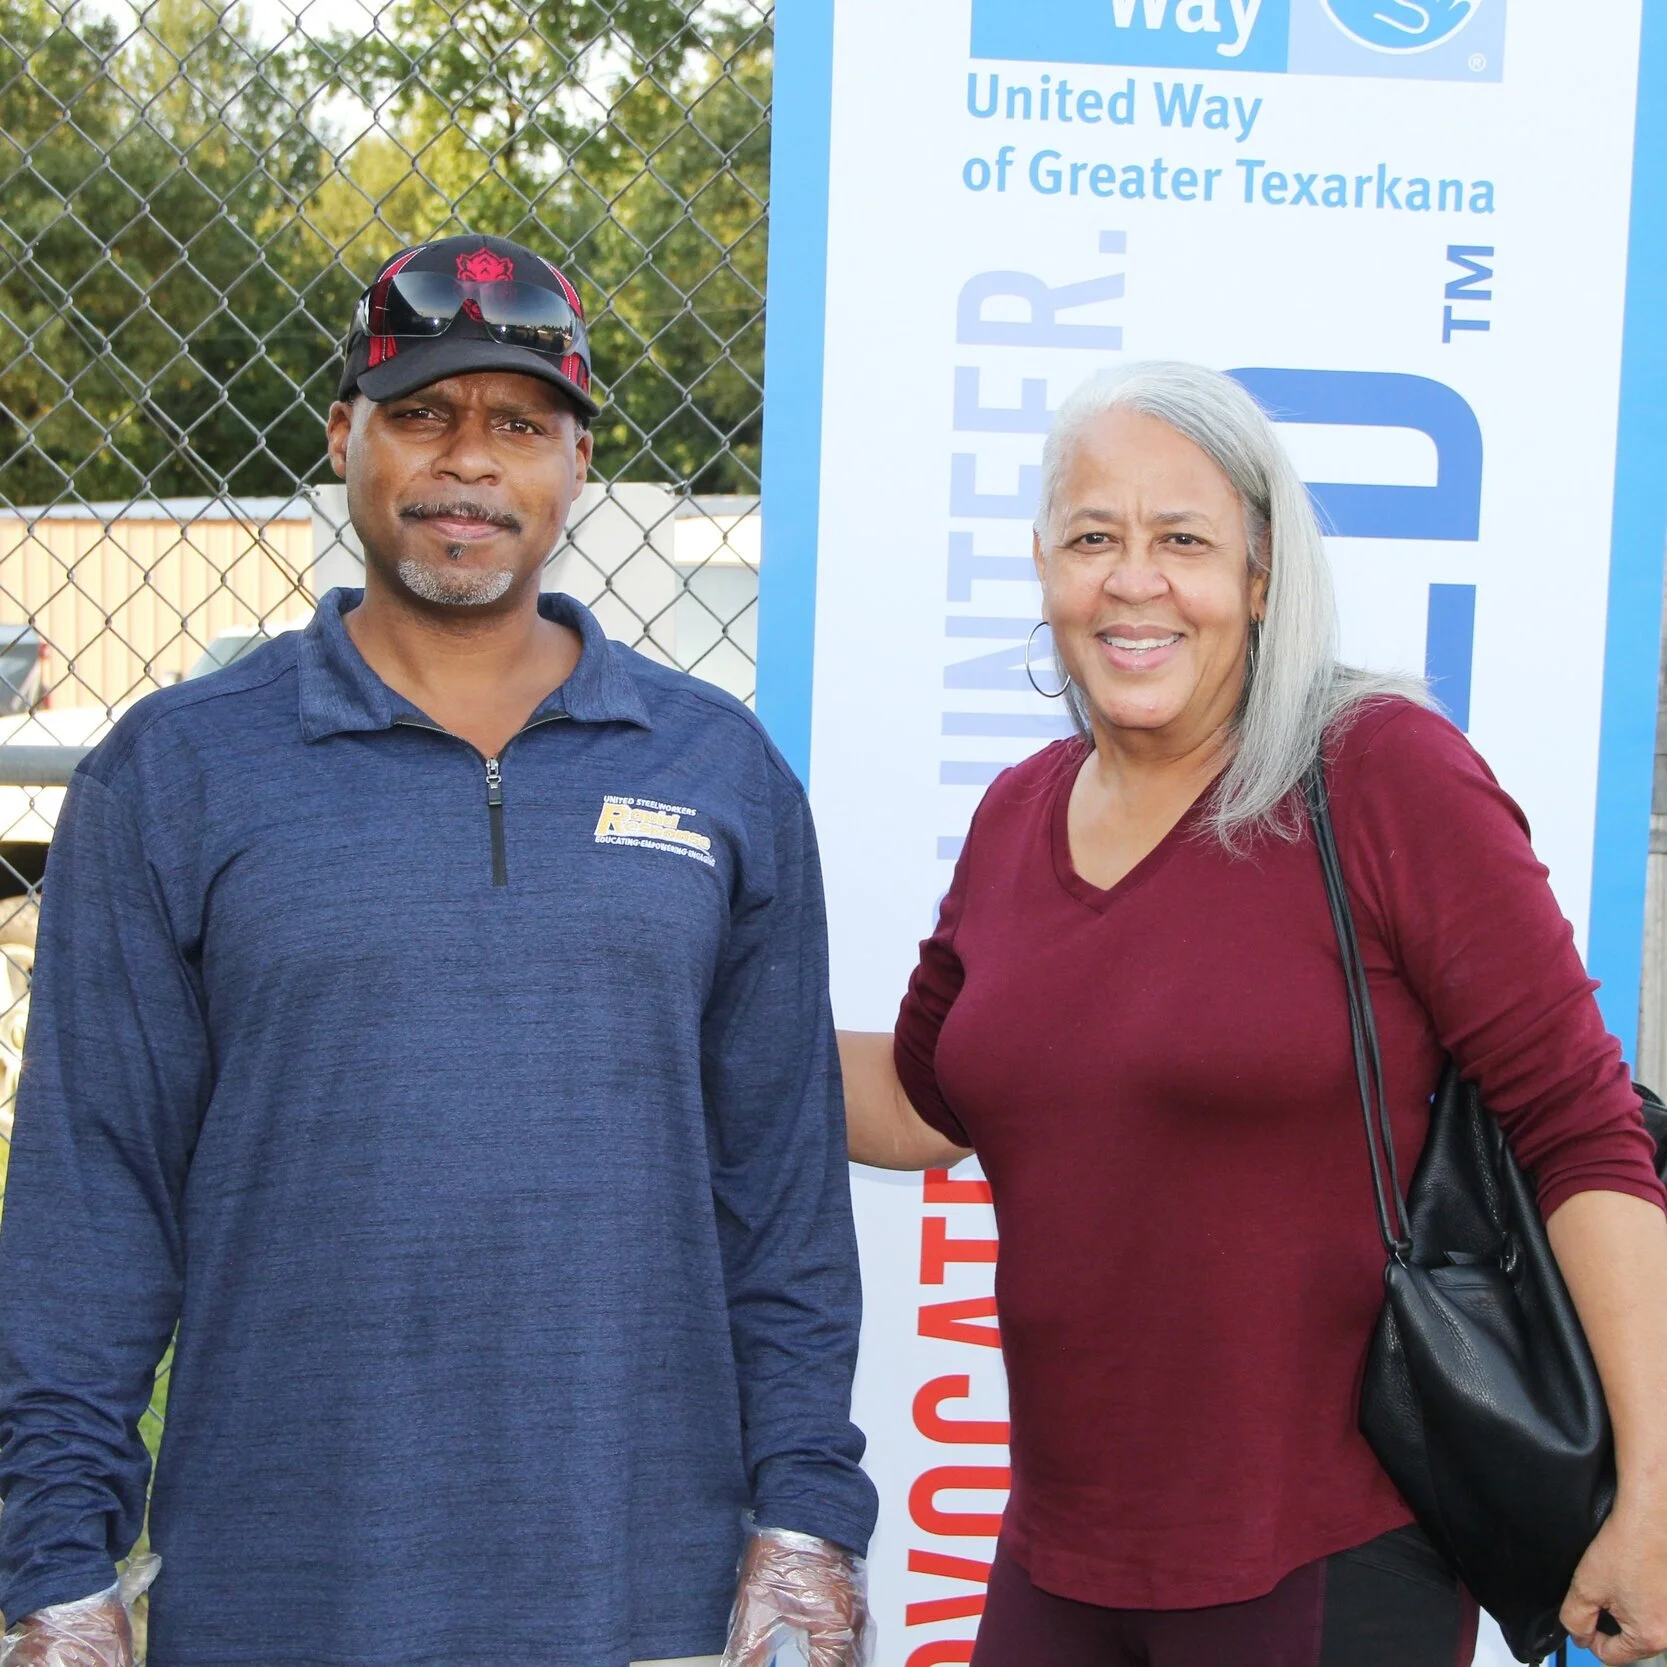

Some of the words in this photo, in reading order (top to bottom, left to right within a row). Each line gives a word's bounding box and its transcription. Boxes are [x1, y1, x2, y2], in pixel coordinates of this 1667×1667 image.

[966, 72, 1136, 125] United
[1153, 81, 1264, 142] Way
[962, 145, 1014, 193] of
[1028, 149, 1222, 203] Greater
[1236, 158, 1495, 214] Texarkana
[603, 795, 634, 805] UNITED
[636, 798, 697, 816] STEELWORKERS
